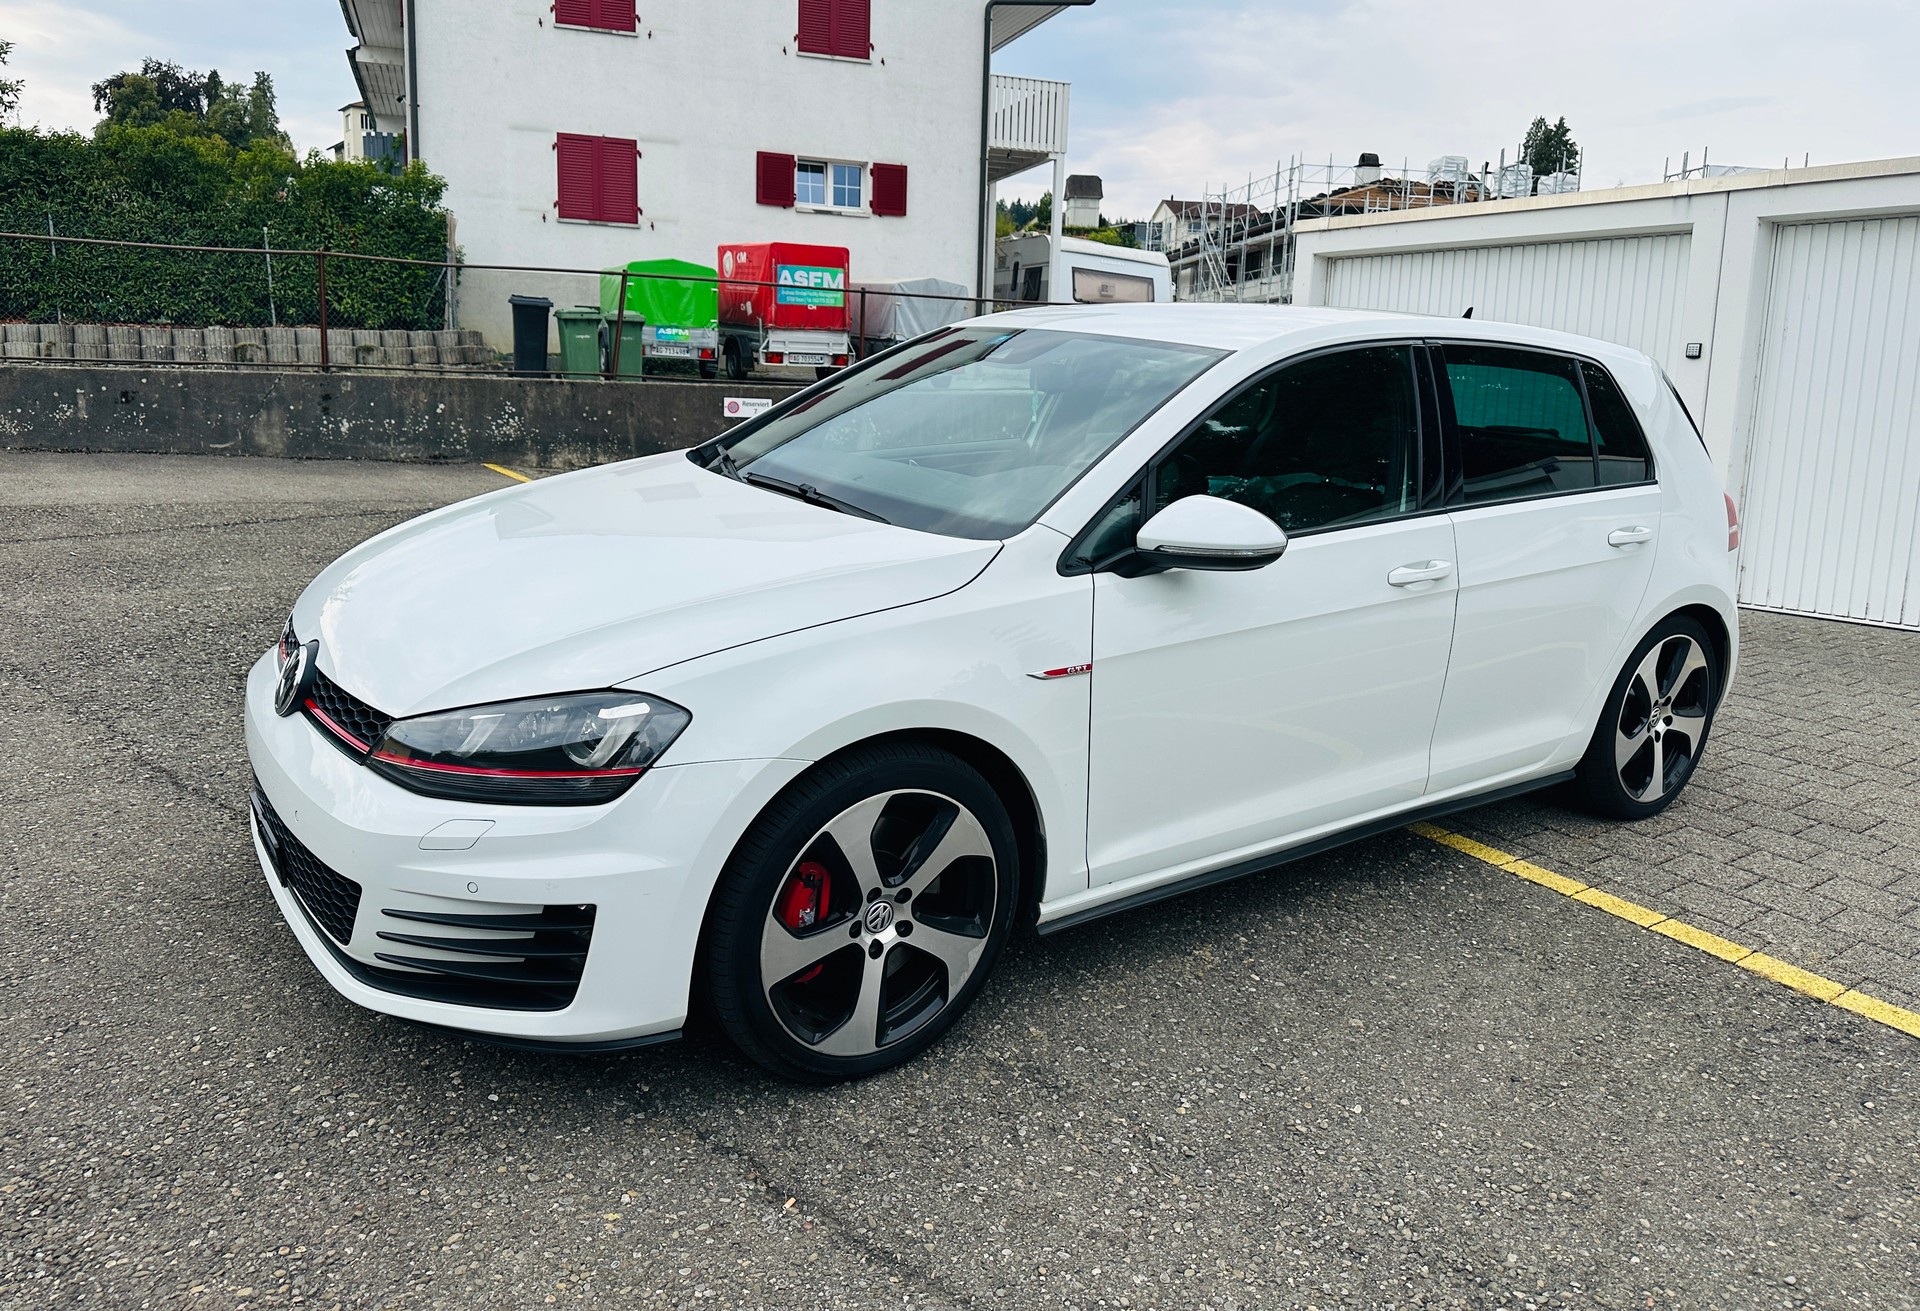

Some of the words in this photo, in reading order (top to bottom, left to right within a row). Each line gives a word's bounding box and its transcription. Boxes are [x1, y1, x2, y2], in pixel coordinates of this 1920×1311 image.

[778, 269, 844, 289] ASFM
[657, 327, 689, 336] ASFM
[741, 400, 770, 408] Reserviert
[1067, 665, 1087, 675] GTI
